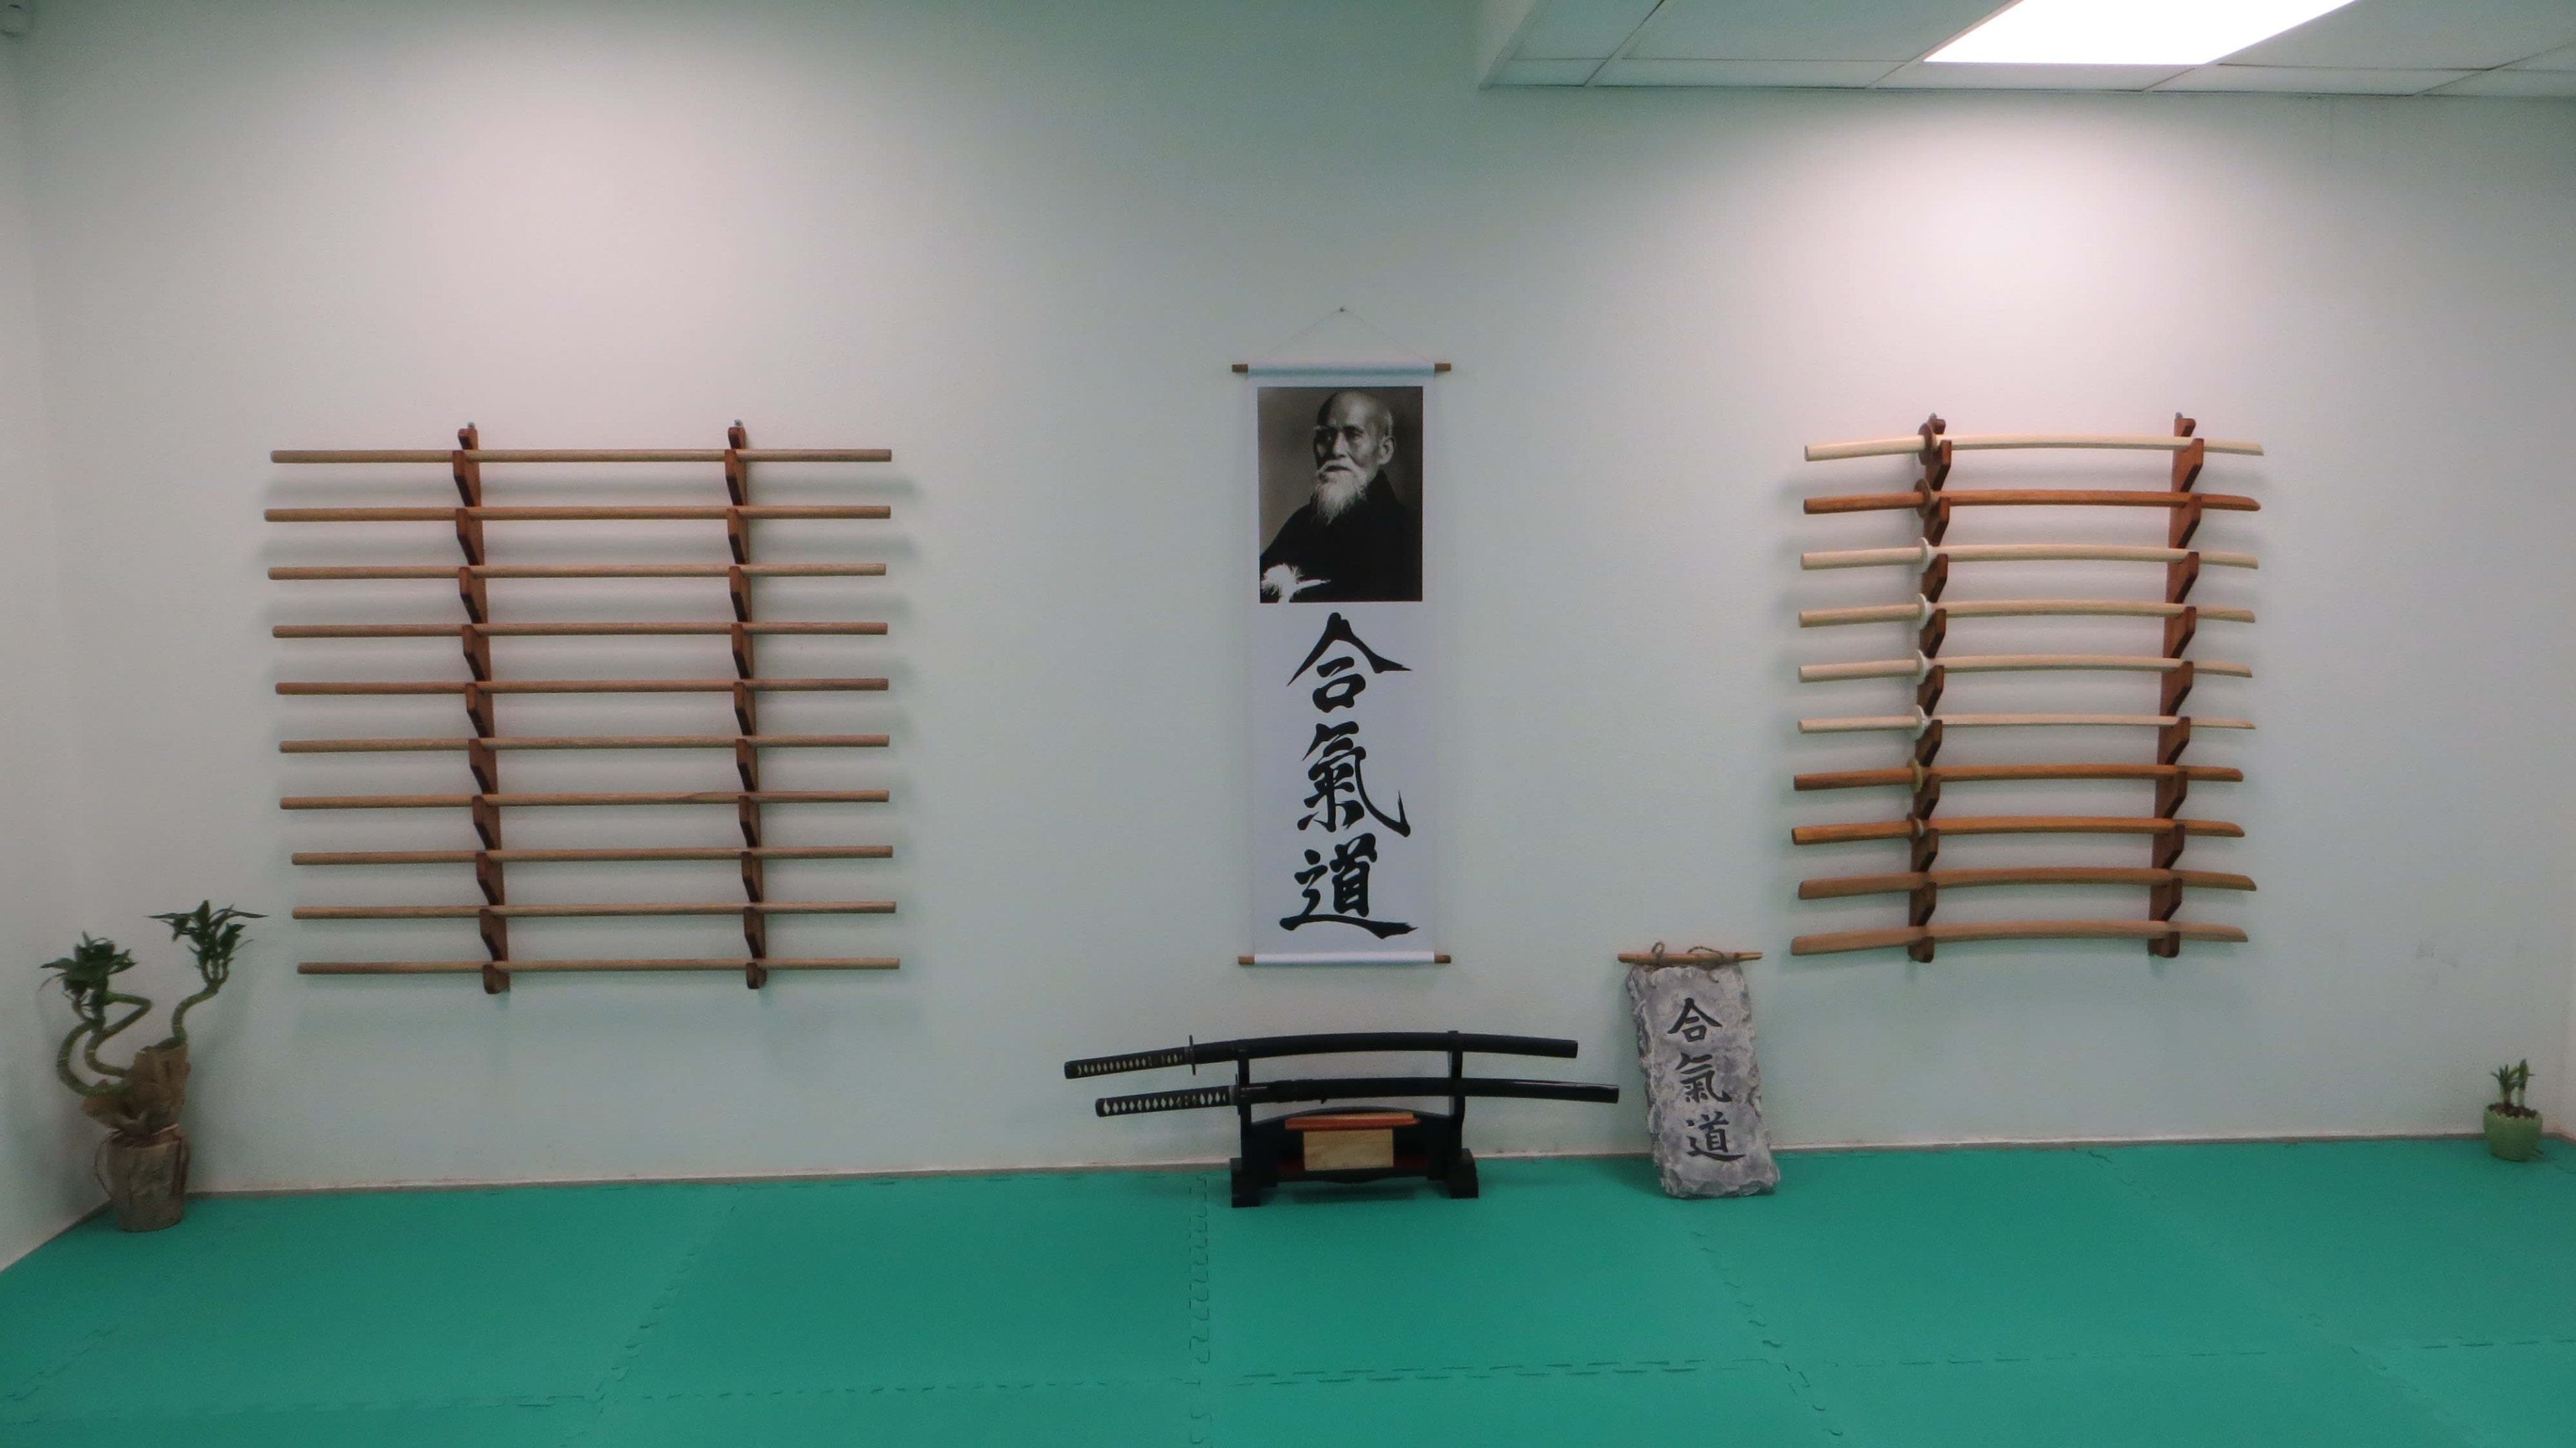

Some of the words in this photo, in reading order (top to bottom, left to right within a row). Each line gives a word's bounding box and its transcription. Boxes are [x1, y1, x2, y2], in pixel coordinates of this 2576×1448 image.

[1279, 612, 1419, 940] 合氣道
[1667, 997, 1746, 1162] 合氣道
